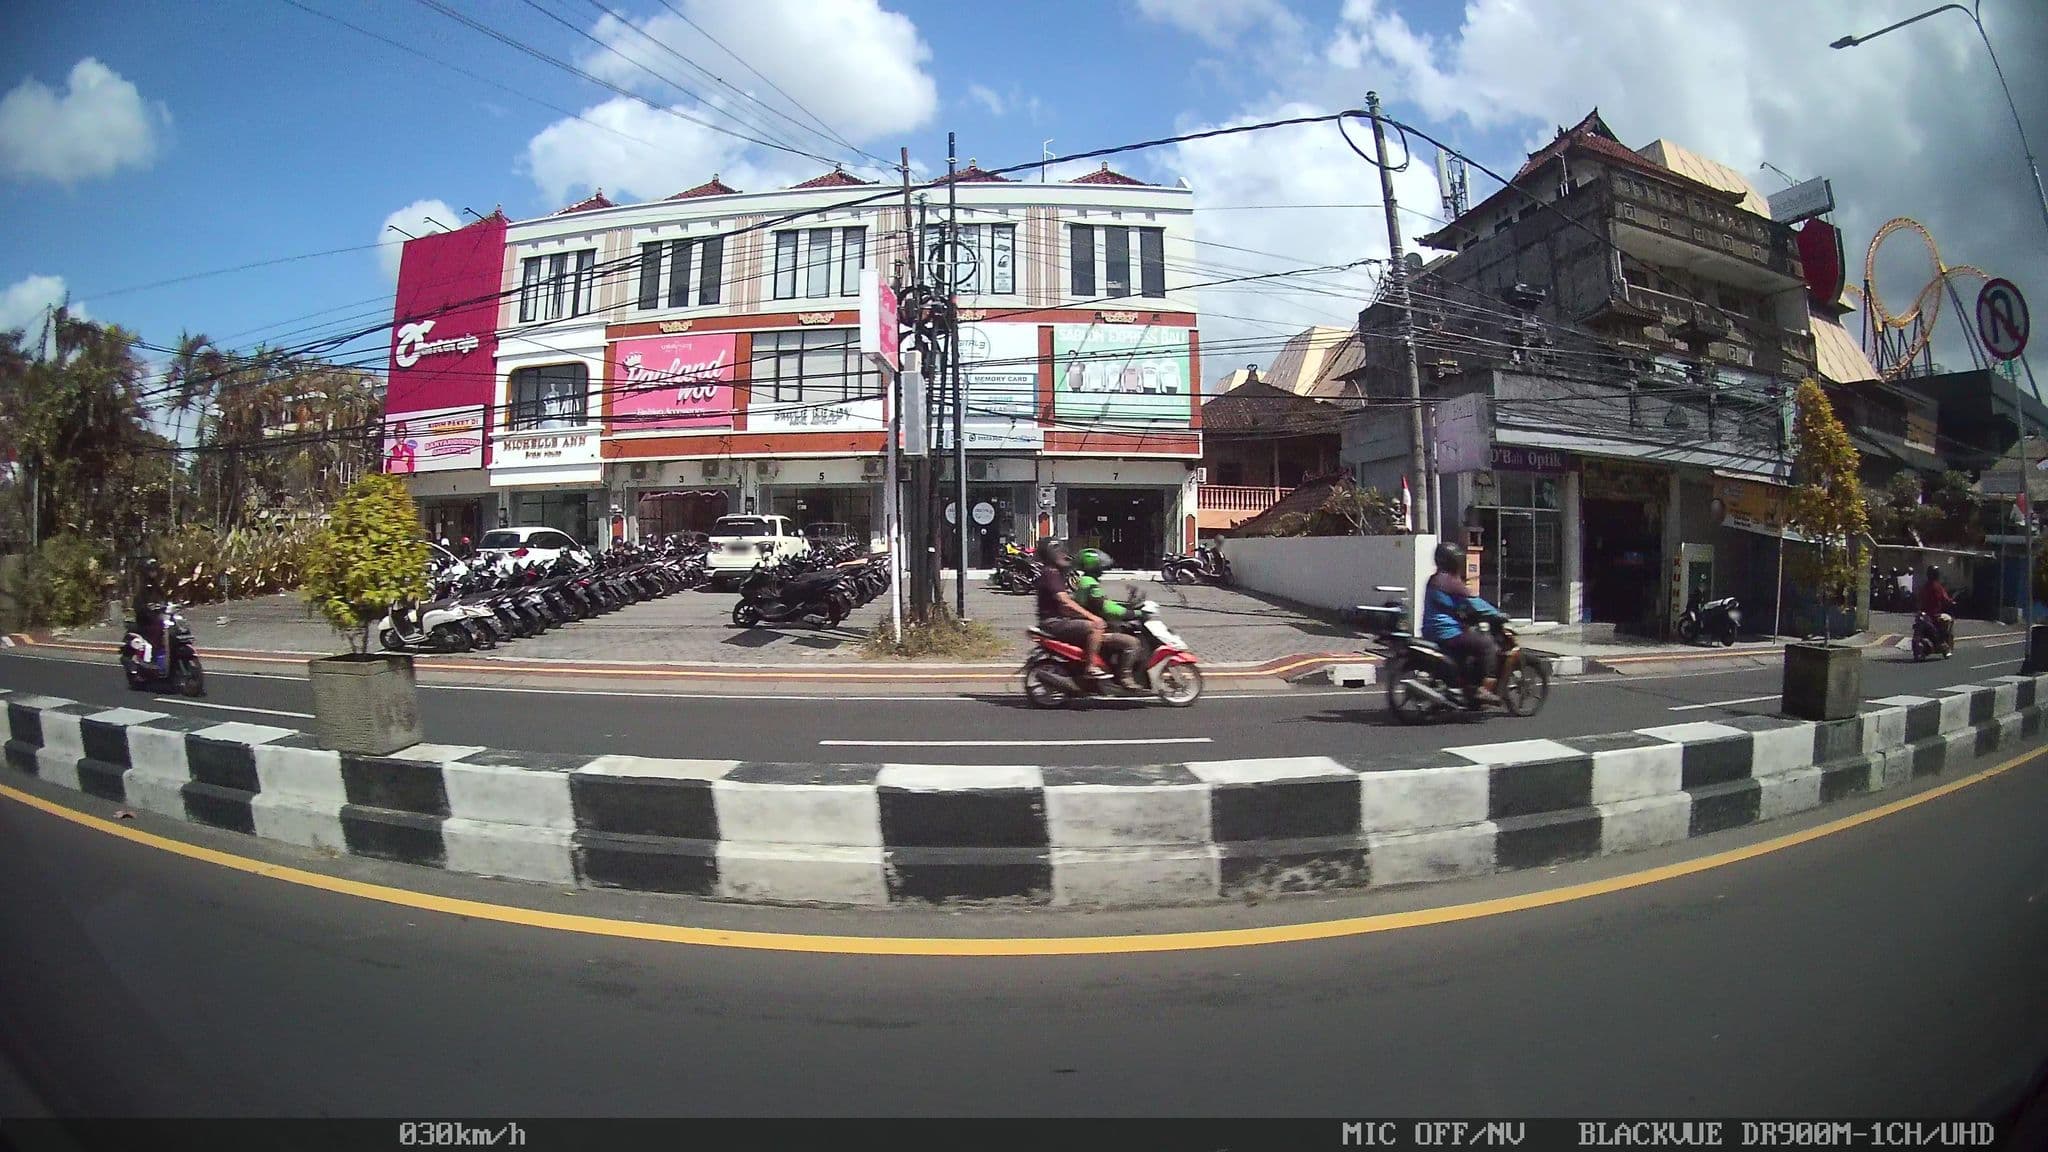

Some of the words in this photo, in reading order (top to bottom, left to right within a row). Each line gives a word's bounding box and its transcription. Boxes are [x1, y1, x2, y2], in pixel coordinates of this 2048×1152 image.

[503, 438, 558, 451] MICHELLE
[562, 435, 587, 447] ANN
[1527, 452, 1562, 469] Optik
[679, 475, 684, 483] 3
[819, 472, 825, 481] 5
[1113, 472, 1119, 480] 7
